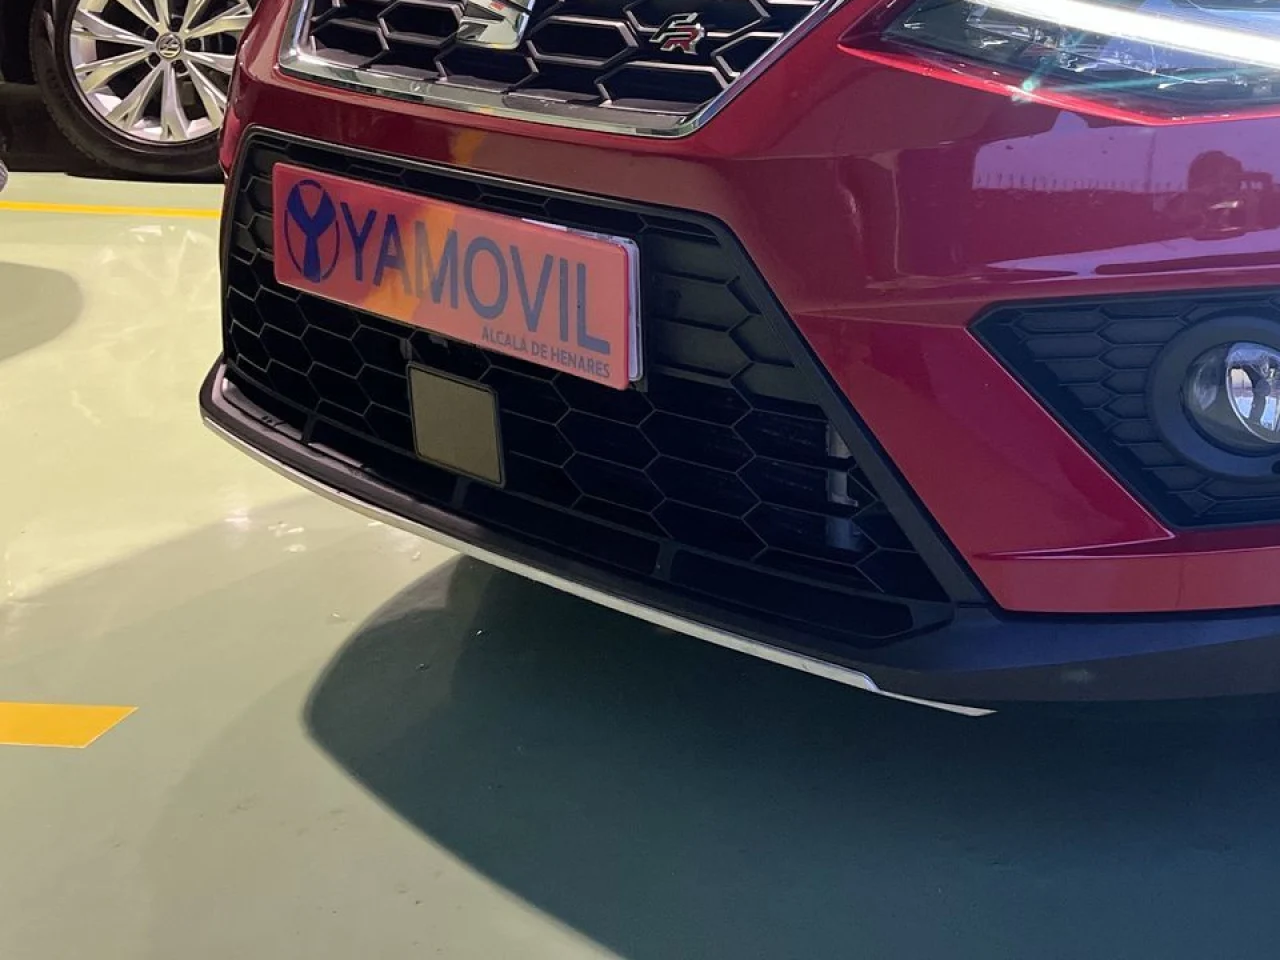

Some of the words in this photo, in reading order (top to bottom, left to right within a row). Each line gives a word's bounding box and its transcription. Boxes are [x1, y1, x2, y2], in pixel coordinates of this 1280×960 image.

[340, 202, 611, 355] YAMOVIL
[531, 342, 549, 358] DE
[550, 348, 611, 379] HENARES
